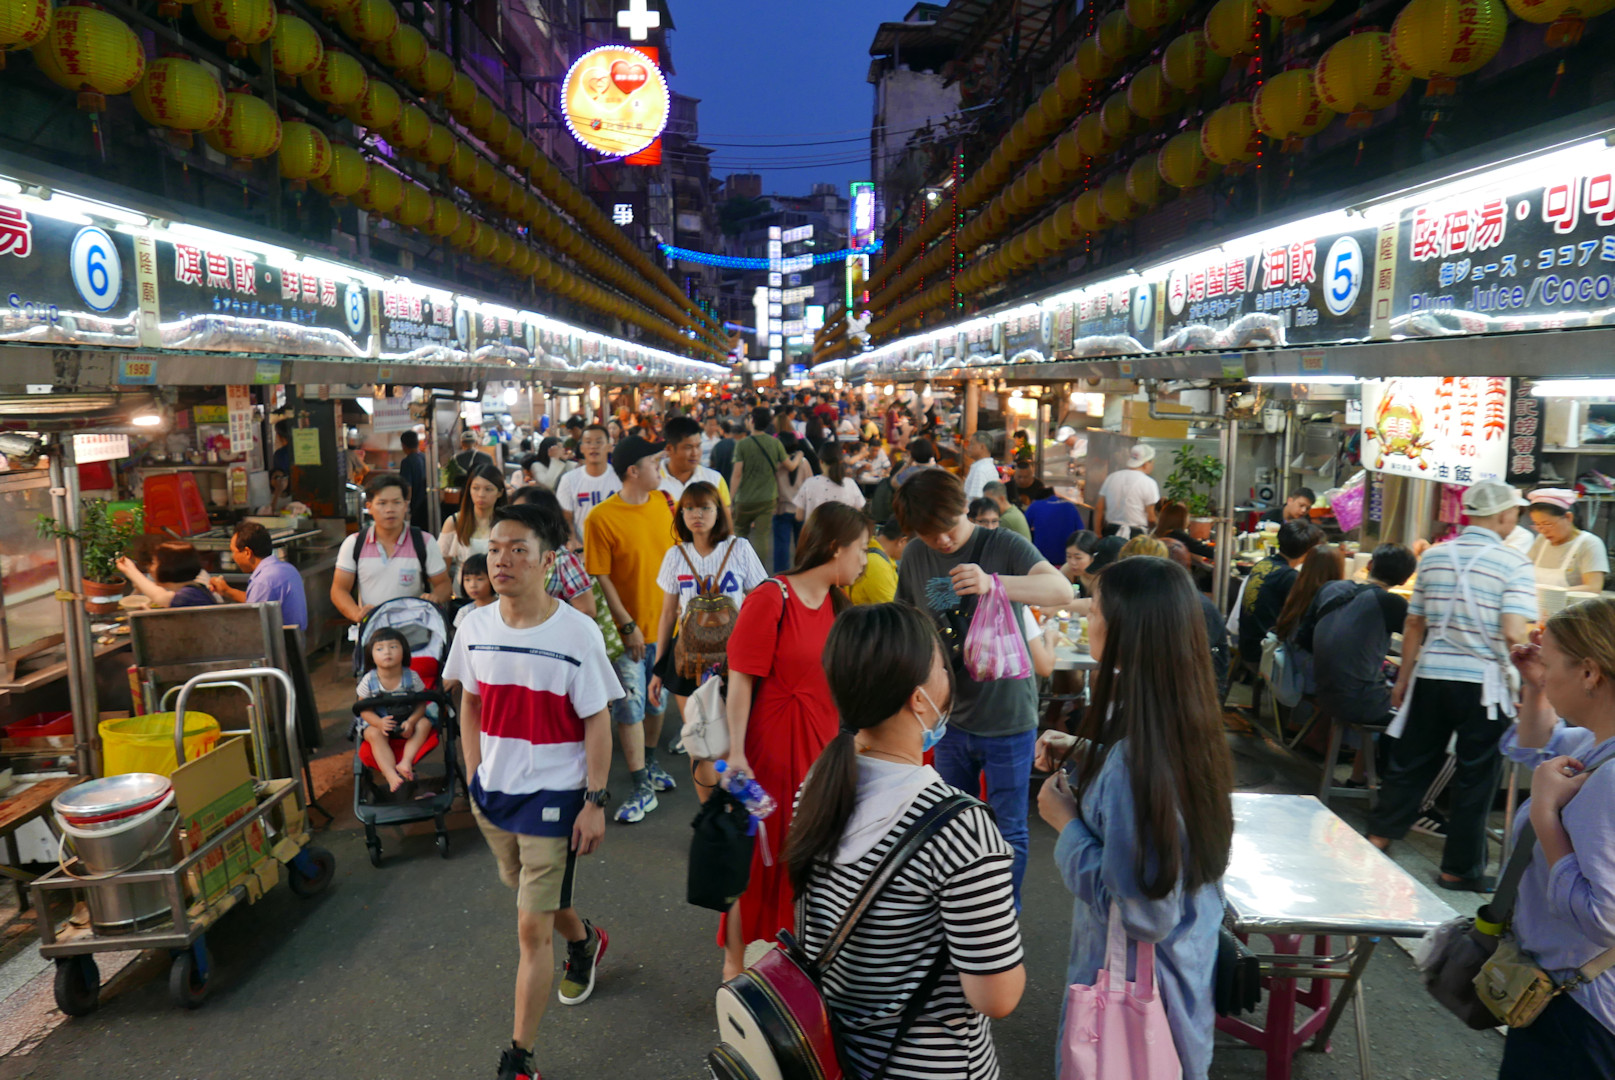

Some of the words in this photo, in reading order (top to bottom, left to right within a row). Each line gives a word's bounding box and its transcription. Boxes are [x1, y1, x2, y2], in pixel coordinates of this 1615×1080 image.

[87, 244, 109, 297] 6
[1332, 252, 1352, 302] 5
[8, 293, 59, 327] Soup
[349, 292, 360, 326] 8
[1465, 273, 1615, 312] Juice/Coco
[1459, 444, 1476, 457] 60
